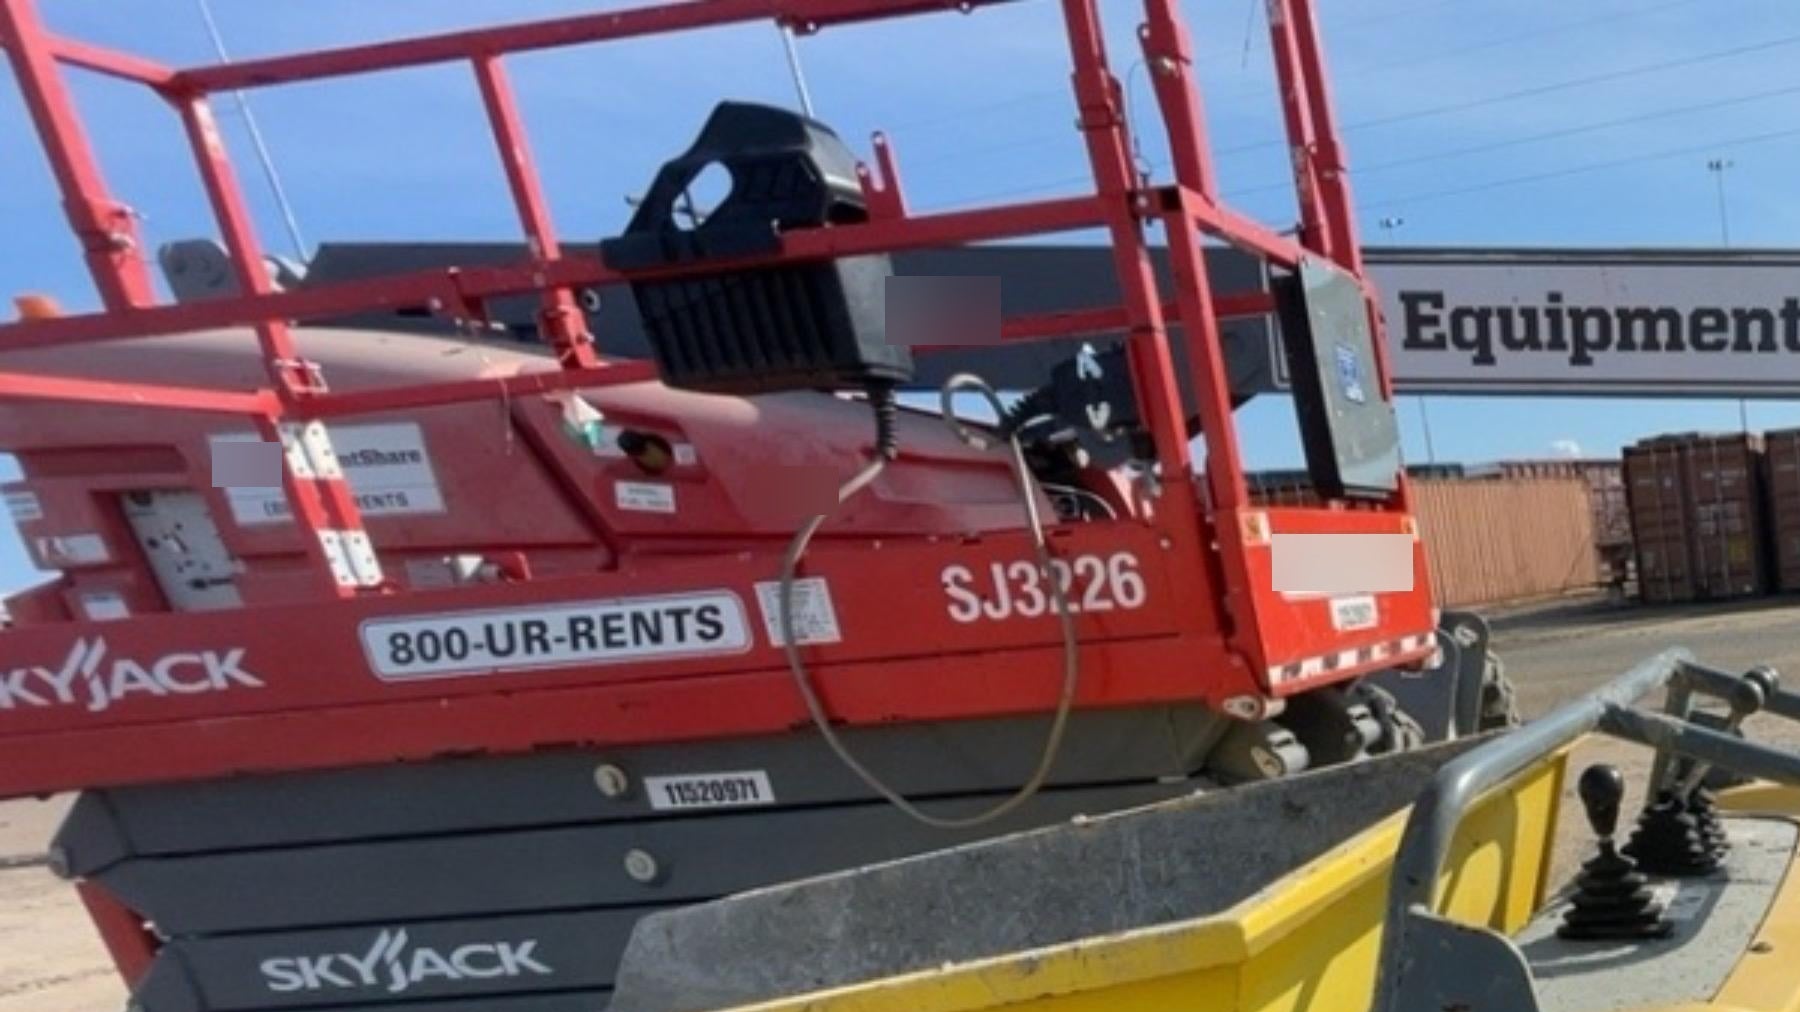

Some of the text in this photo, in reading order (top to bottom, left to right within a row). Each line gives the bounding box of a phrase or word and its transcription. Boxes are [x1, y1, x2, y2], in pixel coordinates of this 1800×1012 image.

[940, 552, 1146, 623] SJ3226
[389, 605, 725, 665] 800-UR-RENTS
[664, 777, 760, 805] 11520971
[260, 927, 554, 993] SKYJACK
